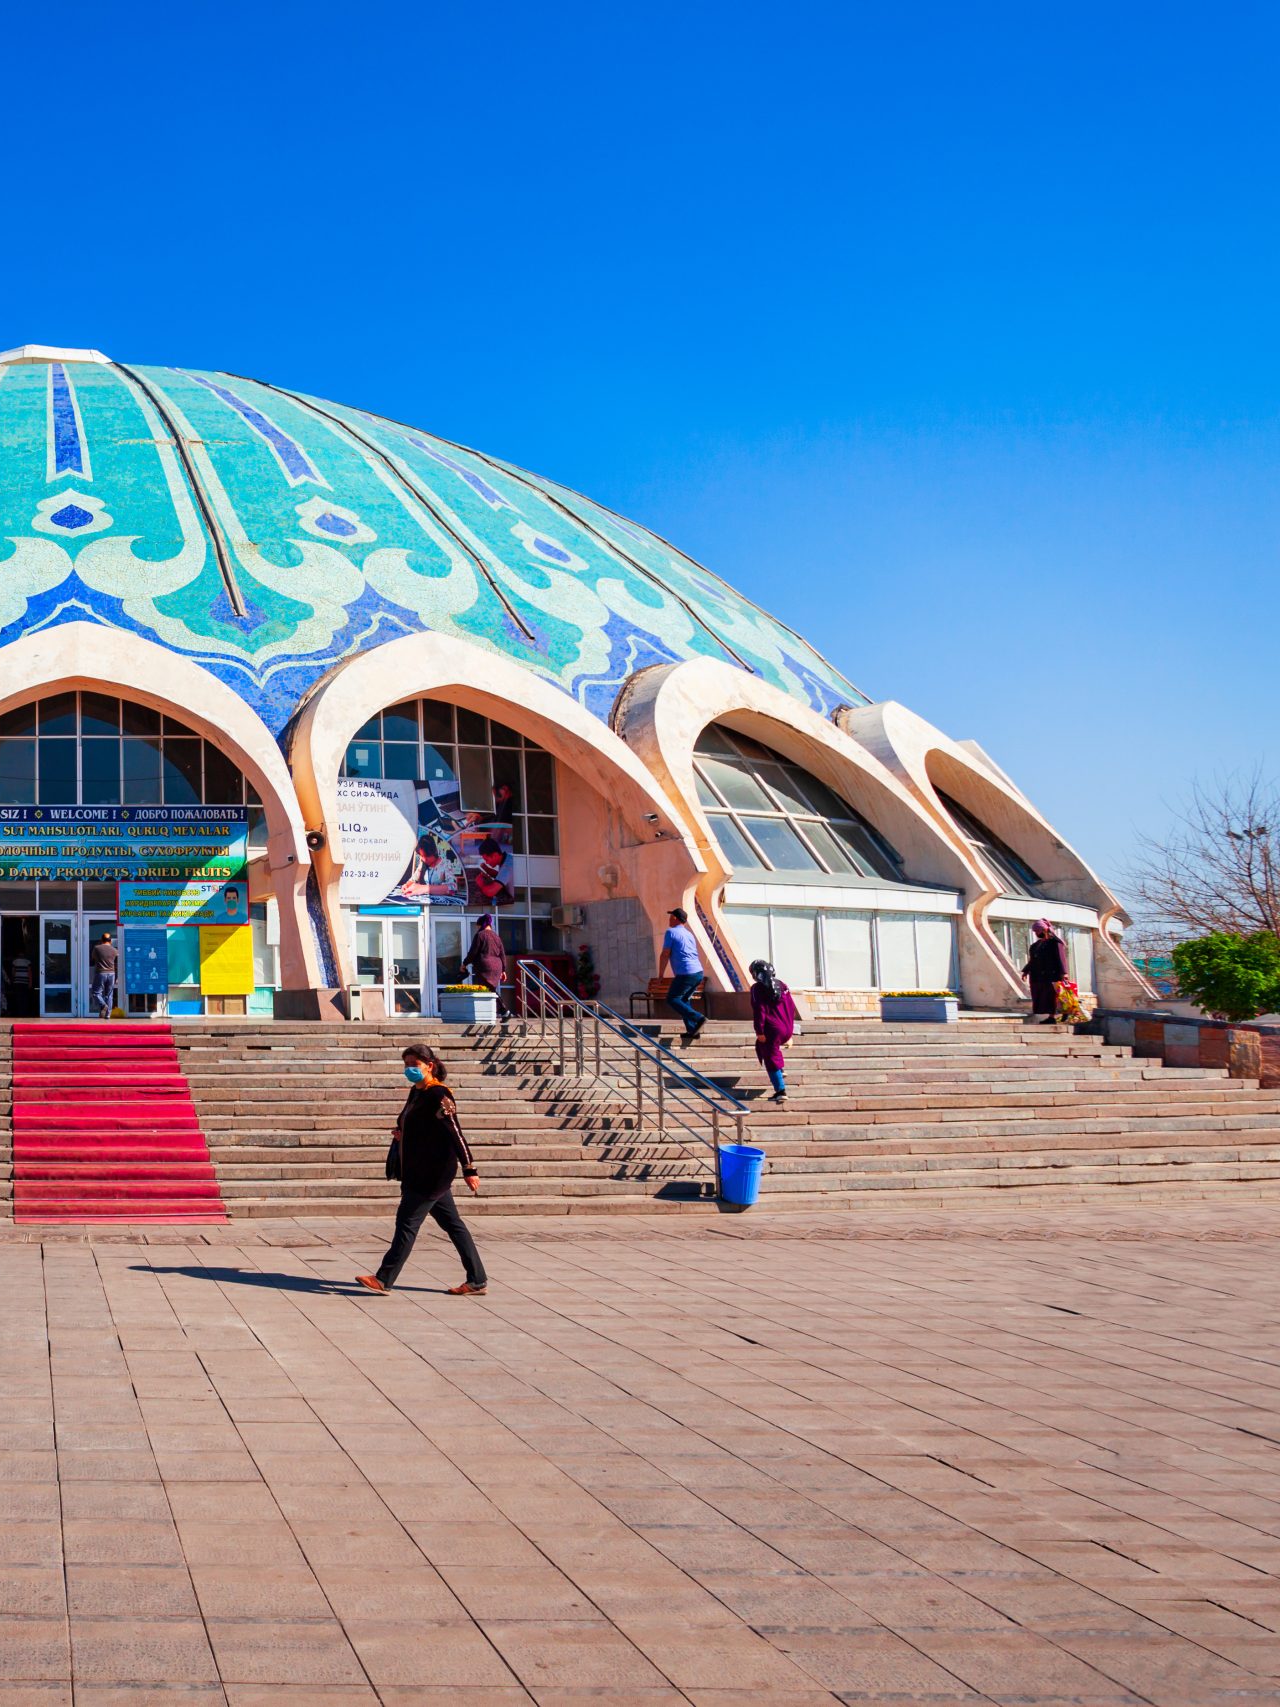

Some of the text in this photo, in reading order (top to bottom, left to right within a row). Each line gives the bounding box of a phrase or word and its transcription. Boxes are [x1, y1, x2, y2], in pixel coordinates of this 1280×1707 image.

[357, 781, 381, 790] БАНД
[351, 790, 399, 799] СИФАТИДА
[50, 809, 109, 820] WELCOME
[134, 809, 168, 821] ДОБРО
[171, 809, 238, 820] ПОЖАЛОВАТЬ
[3, 826, 24, 836] SUT
[28, 826, 123, 837] MAHSULOTLARI,
[127, 826, 169, 837] QURUQ
[173, 826, 231, 836] MEVALAR
[61, 846, 135, 858] ПРОДУКТЫ,
[139, 846, 230, 857] СУХОФРУКТЫ
[9, 867, 52, 877] DAIRY
[56, 867, 133, 878] PRODUCTS,
[137, 867, 180, 877] DRIED
[184, 867, 232, 877] FRUITS
